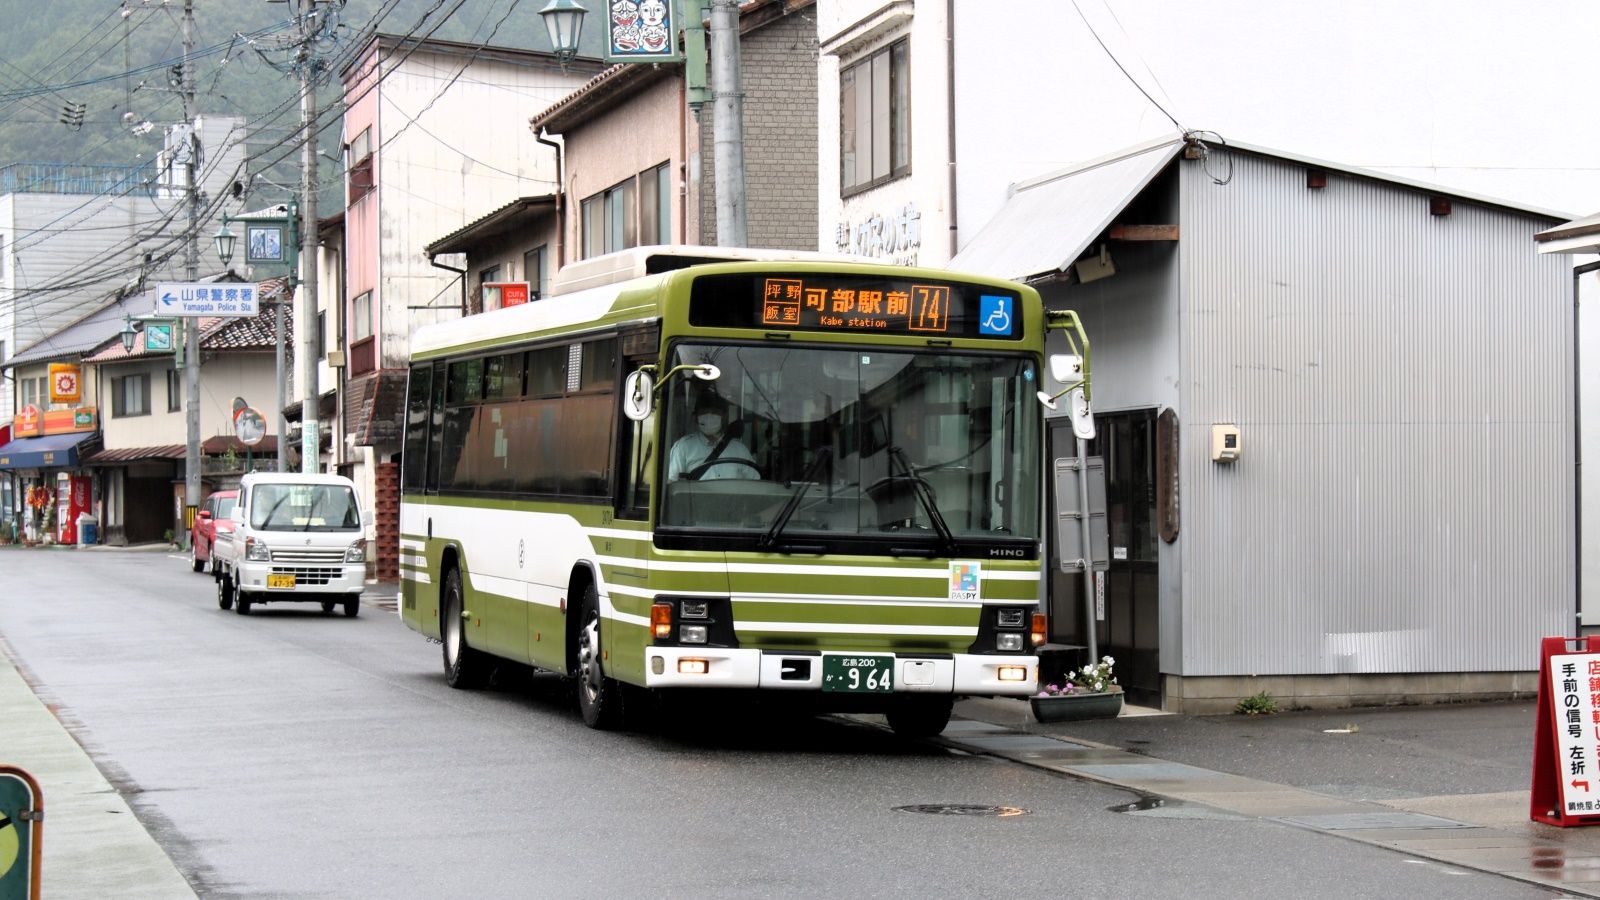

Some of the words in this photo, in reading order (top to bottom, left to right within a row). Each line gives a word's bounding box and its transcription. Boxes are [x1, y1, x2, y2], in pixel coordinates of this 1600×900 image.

[181, 288, 253, 302] 山県警察署
[767, 284, 800, 299] 坪野
[183, 303, 214, 313] Yamagata
[217, 303, 237, 312] Police
[804, 288, 909, 316] 可部駅前
[919, 289, 940, 328] 74
[765, 306, 797, 321] 飯室
[820, 316, 843, 326] Kabe
[848, 317, 887, 328] station
[990, 549, 1025, 557] HINO
[951, 592, 977, 600] PASPY
[1562, 663, 1583, 738] 手前の信号
[1569, 745, 1586, 776] 左折
